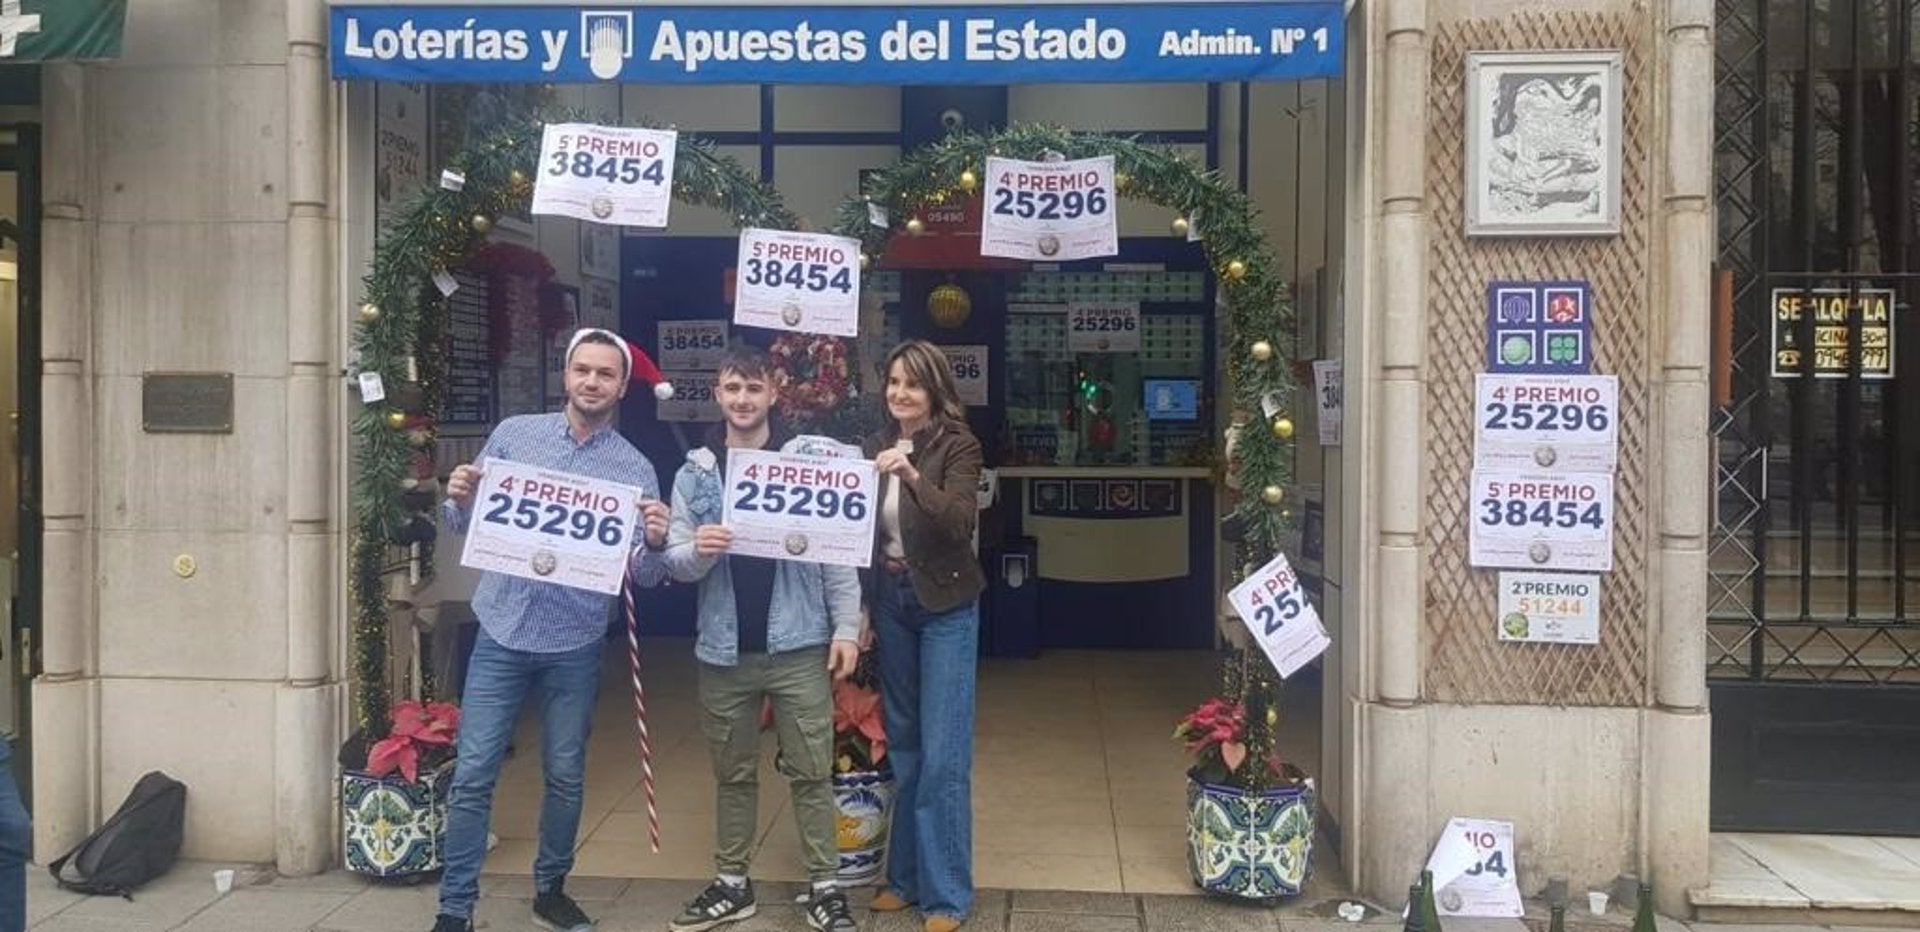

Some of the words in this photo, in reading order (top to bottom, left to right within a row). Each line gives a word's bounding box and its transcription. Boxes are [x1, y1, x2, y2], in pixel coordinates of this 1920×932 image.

[345, 18, 529, 60] Loterías
[541, 29, 569, 72] y
[650, 20, 866, 72] Apuestas
[880, 20, 950, 61] del
[965, 18, 1126, 60] Estado
[1158, 28, 1262, 57] Admin.
[1312, 27, 1328, 52] 1
[577, 135, 659, 158] PREMIO
[548, 151, 665, 186] 38454
[1018, 171, 1099, 191] PREMIO
[993, 187, 1107, 219] 25296
[768, 243, 845, 265] PREMIO
[746, 258, 852, 294] 38454
[1778, 297, 1801, 320] SE
[1073, 316, 1136, 331] 25296
[663, 335, 725, 351] 38454
[1514, 386, 1600, 403] PREMIO
[1485, 402, 1609, 431] 25296
[768, 465, 860, 490] PREMIO
[522, 479, 620, 514] PREMIO
[734, 481, 867, 521] 25296
[1508, 483, 1596, 501] PREMIO
[483, 493, 624, 546] 25296
[1481, 498, 1604, 529] 38454
[1518, 597, 1581, 615] 51244
